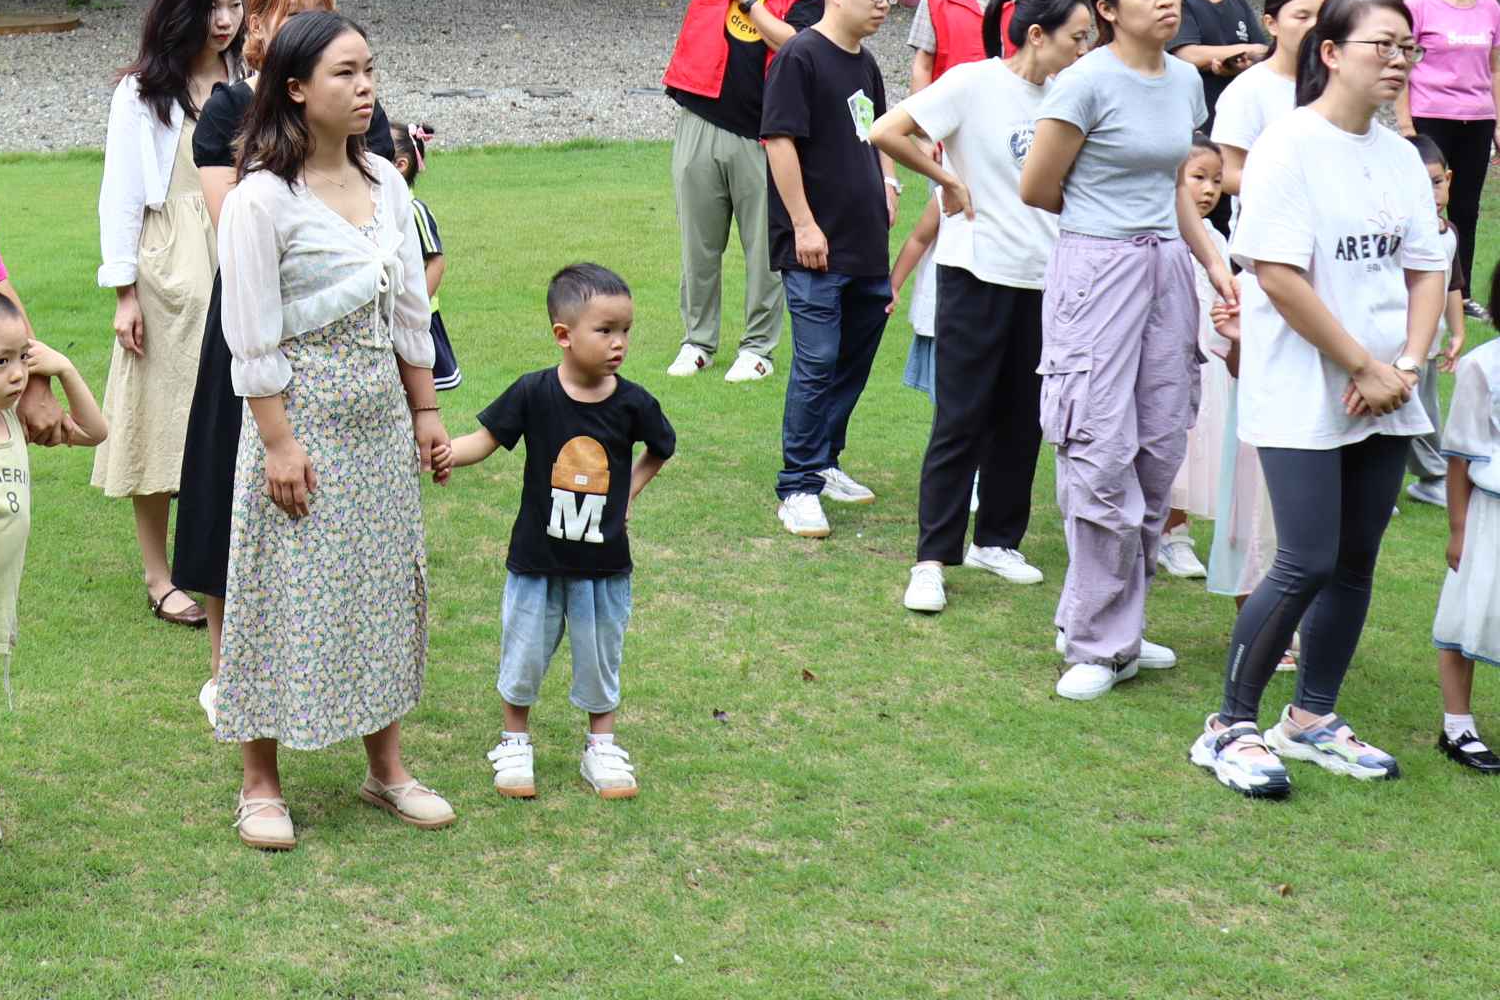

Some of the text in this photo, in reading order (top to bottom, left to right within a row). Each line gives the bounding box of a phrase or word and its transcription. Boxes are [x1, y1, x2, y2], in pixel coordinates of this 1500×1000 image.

[1335, 234, 1370, 261] ARE
[7, 491, 20, 514] 8
[547, 488, 607, 543] M
